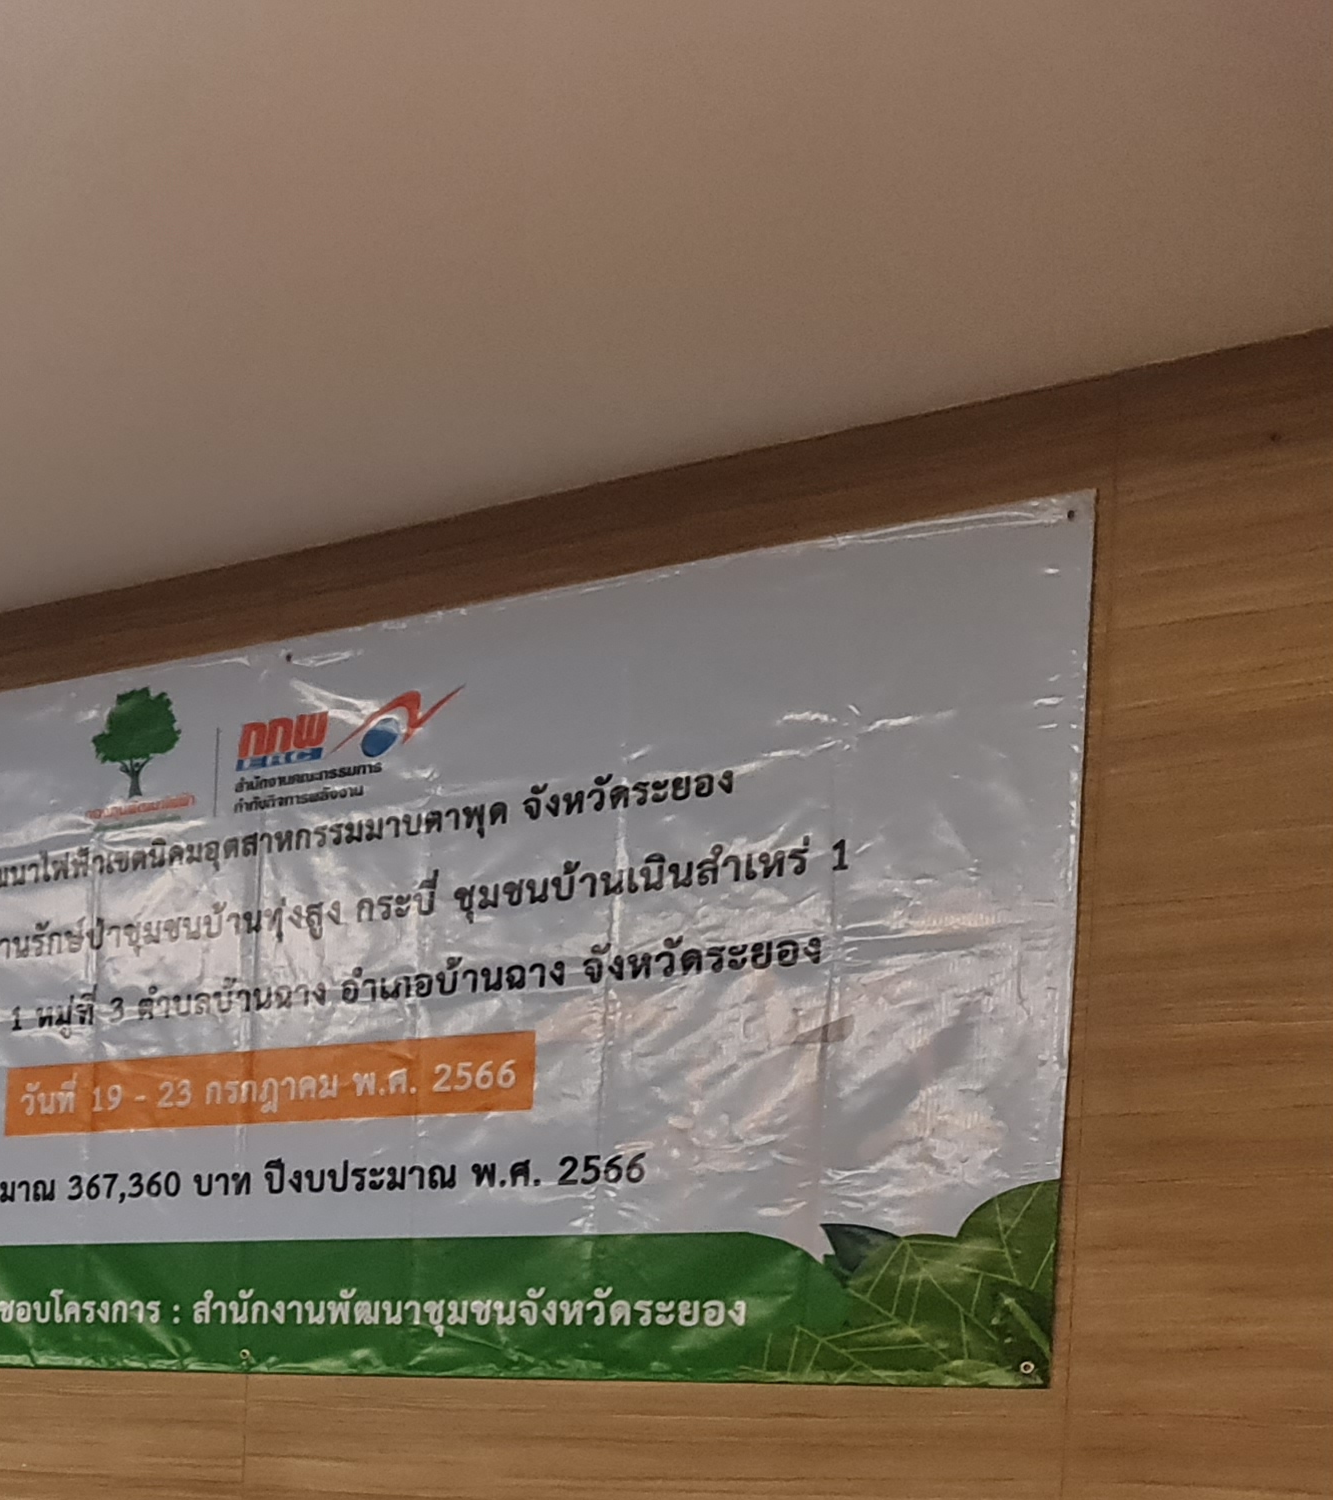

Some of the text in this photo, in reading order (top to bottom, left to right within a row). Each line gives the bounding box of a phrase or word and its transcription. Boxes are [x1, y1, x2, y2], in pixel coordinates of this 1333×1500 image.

[523, 770, 735, 822] จังหวัดระยอง
[356, 869, 438, 924] กระบี่
[454, 835, 811, 924] ชุมชนบ้านเนินสำเหร่
[831, 838, 850, 872] 1
[11, 1006, 24, 1031] 1
[36, 984, 96, 1040] หมู่ที่
[110, 996, 126, 1024] 3
[137, 974, 327, 1022] ตำบลบ้านฉาง
[341, 955, 566, 1004] อำเภอบ้านฉาง
[583, 934, 822, 984] จังหวัดระยอง
[20, 1073, 79, 1118] วันที่
[92, 1084, 123, 1114] 19
[158, 1078, 192, 1109] 23
[205, 1072, 338, 1114] กรกฎาคม
[353, 1065, 417, 1097] พ.ศ.
[432, 1060, 517, 1093] 2566
[67, 1171, 181, 1204] 367,360
[193, 1170, 251, 1198] บาท
[265, 1157, 457, 1196] ปีงบประมาณ
[471, 1156, 541, 1189] พ.ศ.
[558, 1152, 646, 1186] 2566
[191, 1287, 748, 1337] สำนักงานพัฒนาชุมชนจังหวัดระยอง
